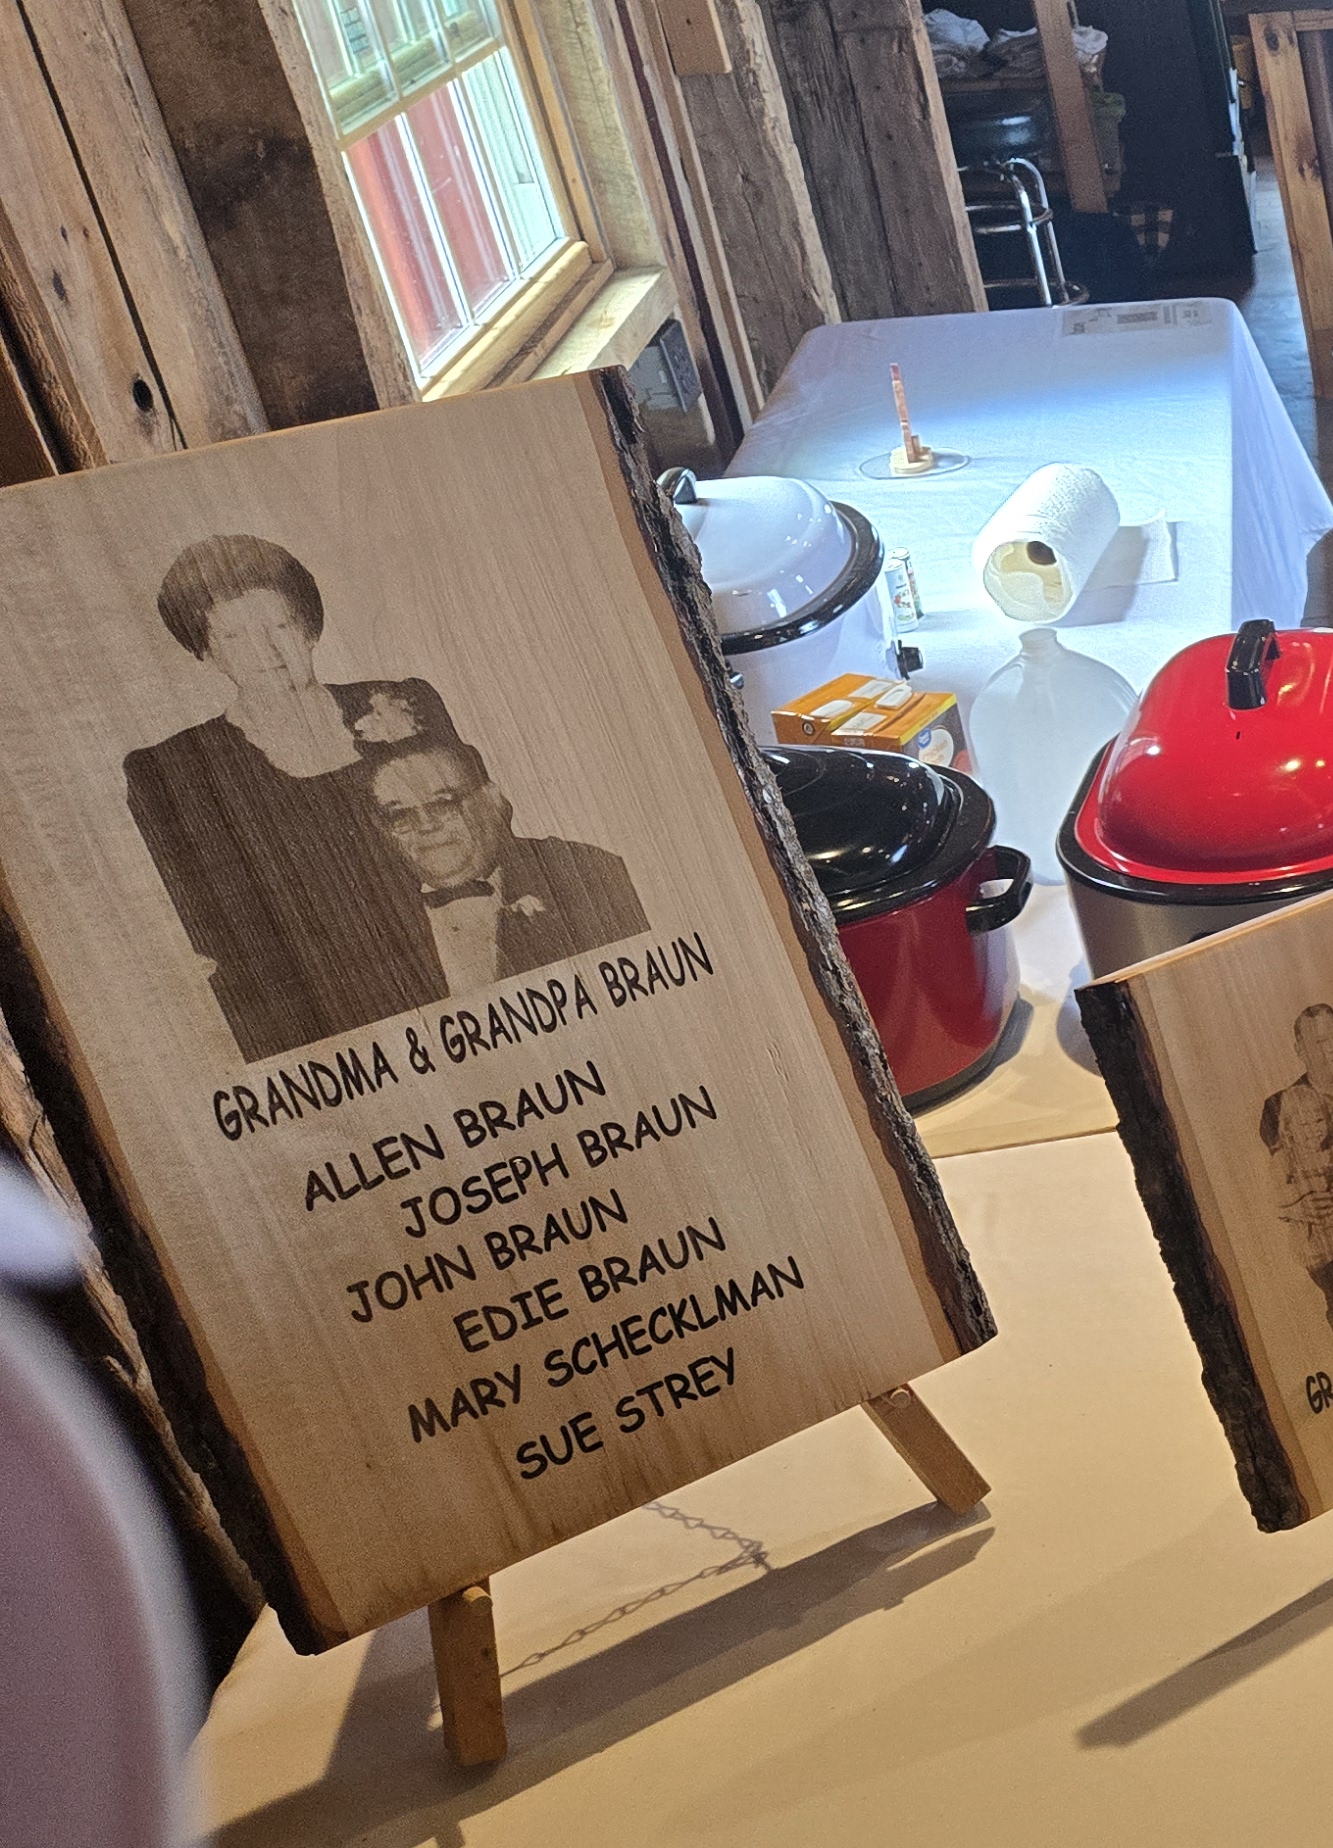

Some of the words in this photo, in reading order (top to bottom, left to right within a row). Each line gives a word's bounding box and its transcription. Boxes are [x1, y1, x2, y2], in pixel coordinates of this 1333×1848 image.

[214, 1042, 398, 1140] GRANDMA
[406, 1026, 434, 1075] &
[440, 974, 598, 1064] GRANDPA
[600, 932, 714, 1009] BRAUN
[305, 1123, 445, 1211] ALLEN
[453, 1060, 607, 1149] BRAUN
[401, 1142, 570, 1239] JOSEPH
[577, 1085, 718, 1169] BRAUN
[346, 1244, 477, 1324] JOHN
[485, 1188, 629, 1271] BRAUN
[453, 1278, 569, 1354] EDIE
[579, 1217, 727, 1304] BRAUN
[408, 1363, 523, 1443] MARY
[546, 1256, 805, 1388] SCHECKLMAN
[516, 1411, 604, 1480] SUE
[618, 1347, 736, 1434] STREY
